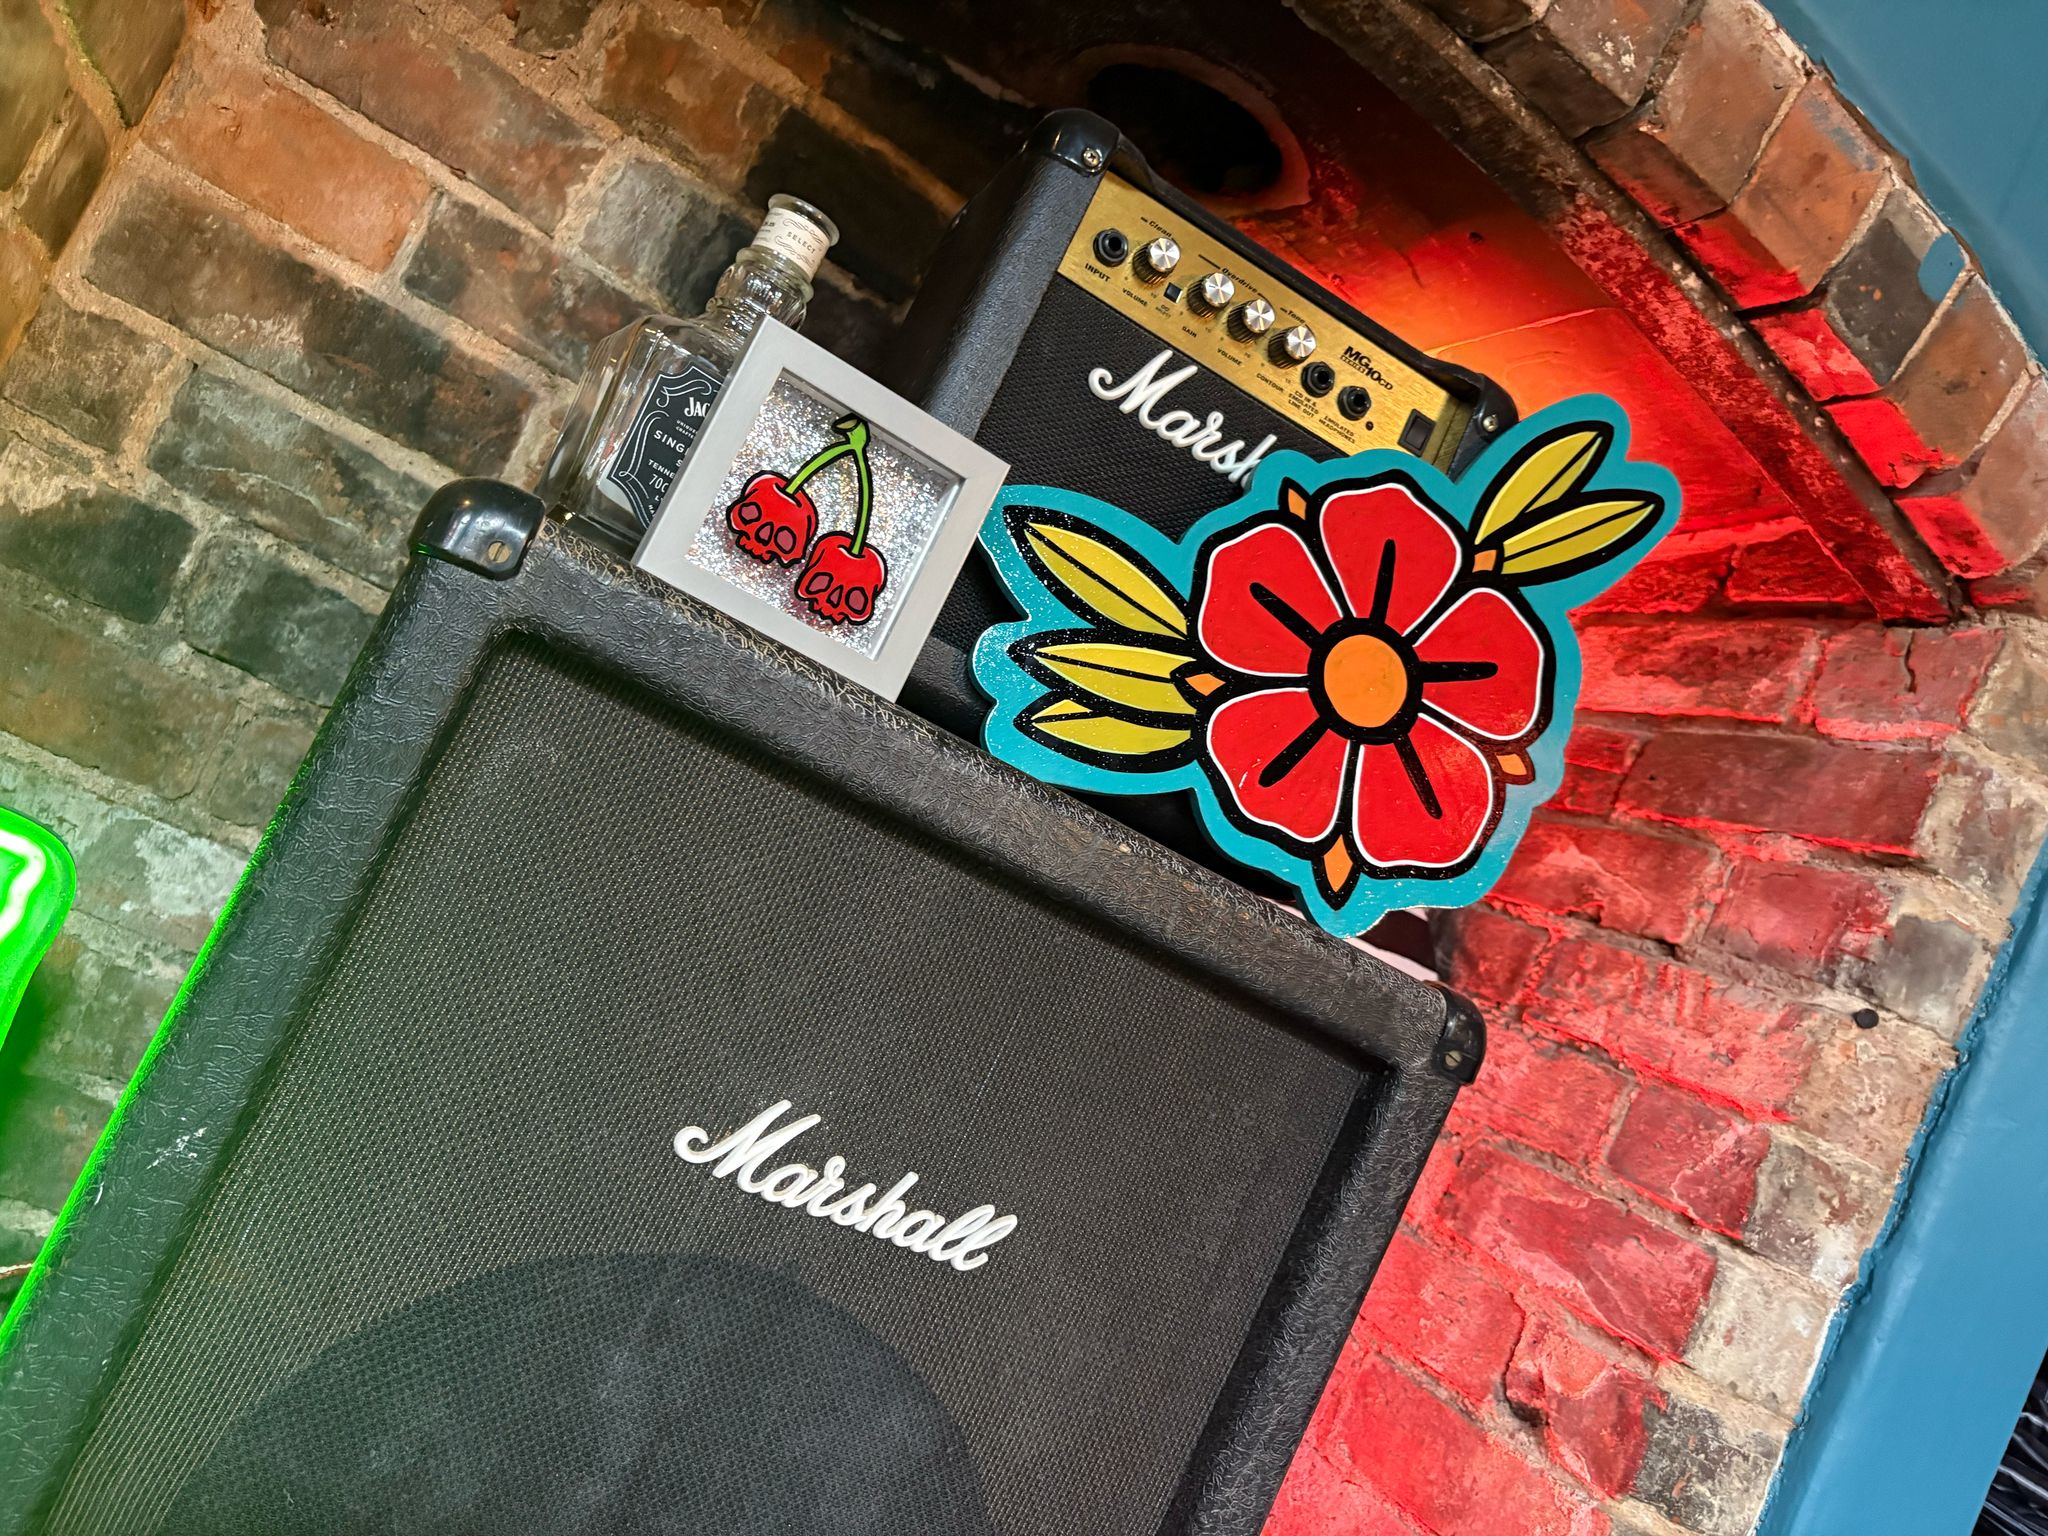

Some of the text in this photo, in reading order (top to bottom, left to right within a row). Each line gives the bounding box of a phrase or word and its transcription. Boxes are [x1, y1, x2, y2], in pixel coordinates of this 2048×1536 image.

[1149, 220, 1172, 237] Clean
[787, 231, 815, 254] SELECT
[1085, 262, 1111, 283] INPUT
[1222, 267, 1258, 293] Overdrive
[1122, 287, 1148, 307] VOLUME
[1287, 310, 1306, 323] Tone
[1182, 325, 1197, 338] GAIN
[1217, 347, 1243, 366] VOLUME
[1256, 372, 1285, 393] CONTOUR
[676, 420, 698, 434] UNIQUE
[653, 430, 689, 456] SING
[673, 1099, 1018, 1272] Marshall
